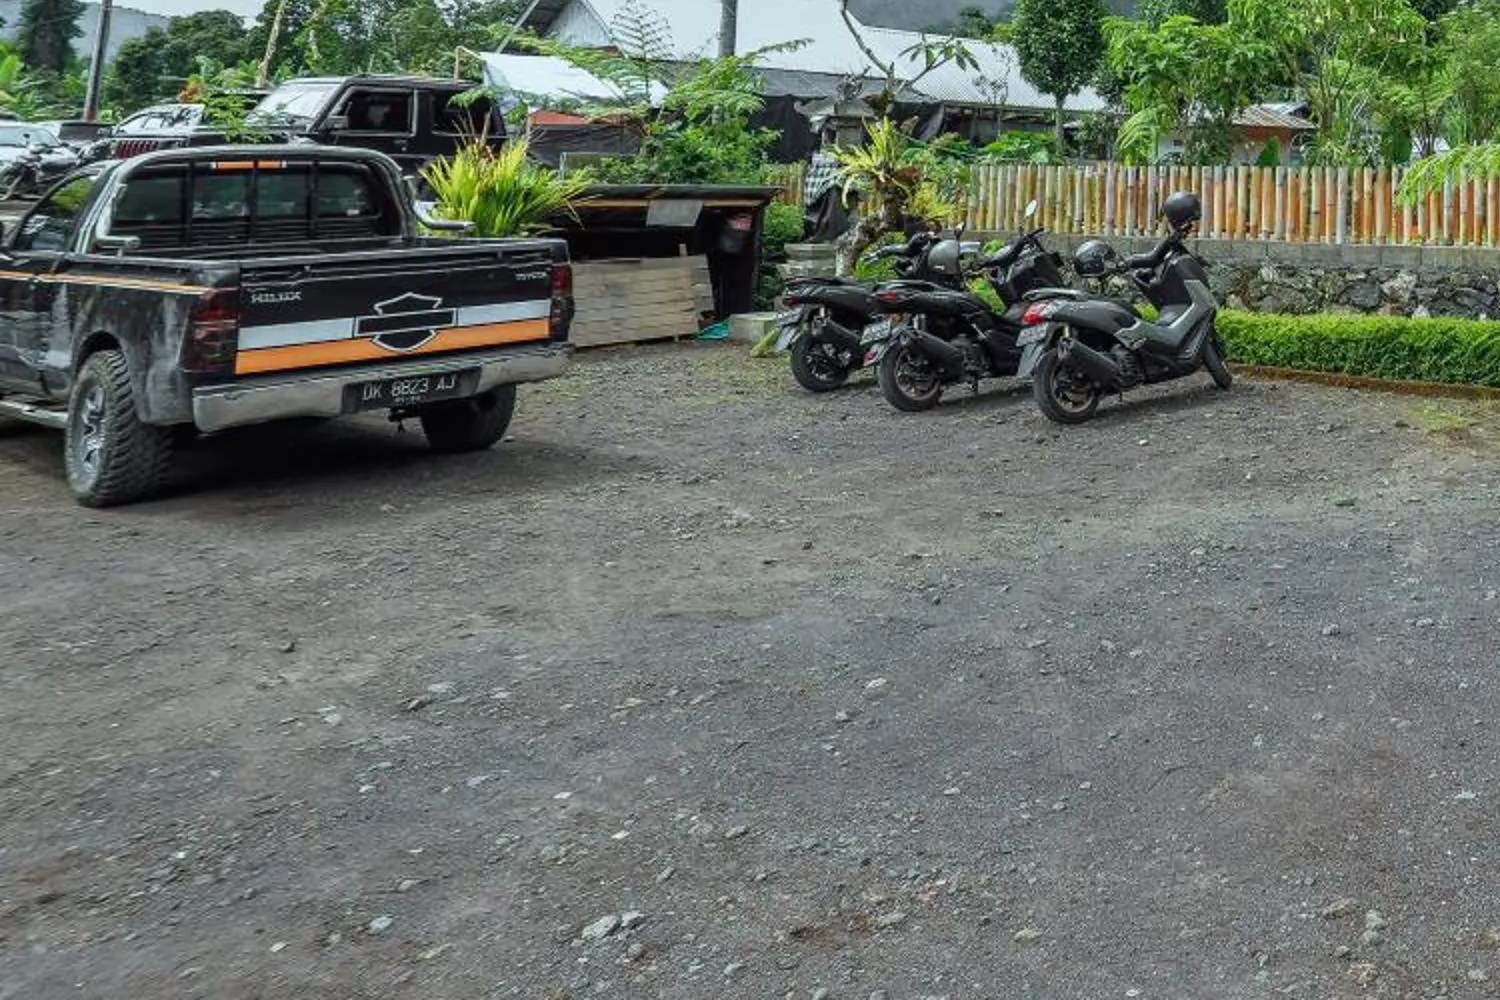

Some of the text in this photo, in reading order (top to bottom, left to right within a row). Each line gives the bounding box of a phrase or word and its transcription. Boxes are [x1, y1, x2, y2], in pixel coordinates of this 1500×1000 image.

[251, 291, 302, 305] HILUX
[362, 383, 382, 401] DK
[391, 377, 429, 397] 8823
[435, 374, 457, 391] AJ
